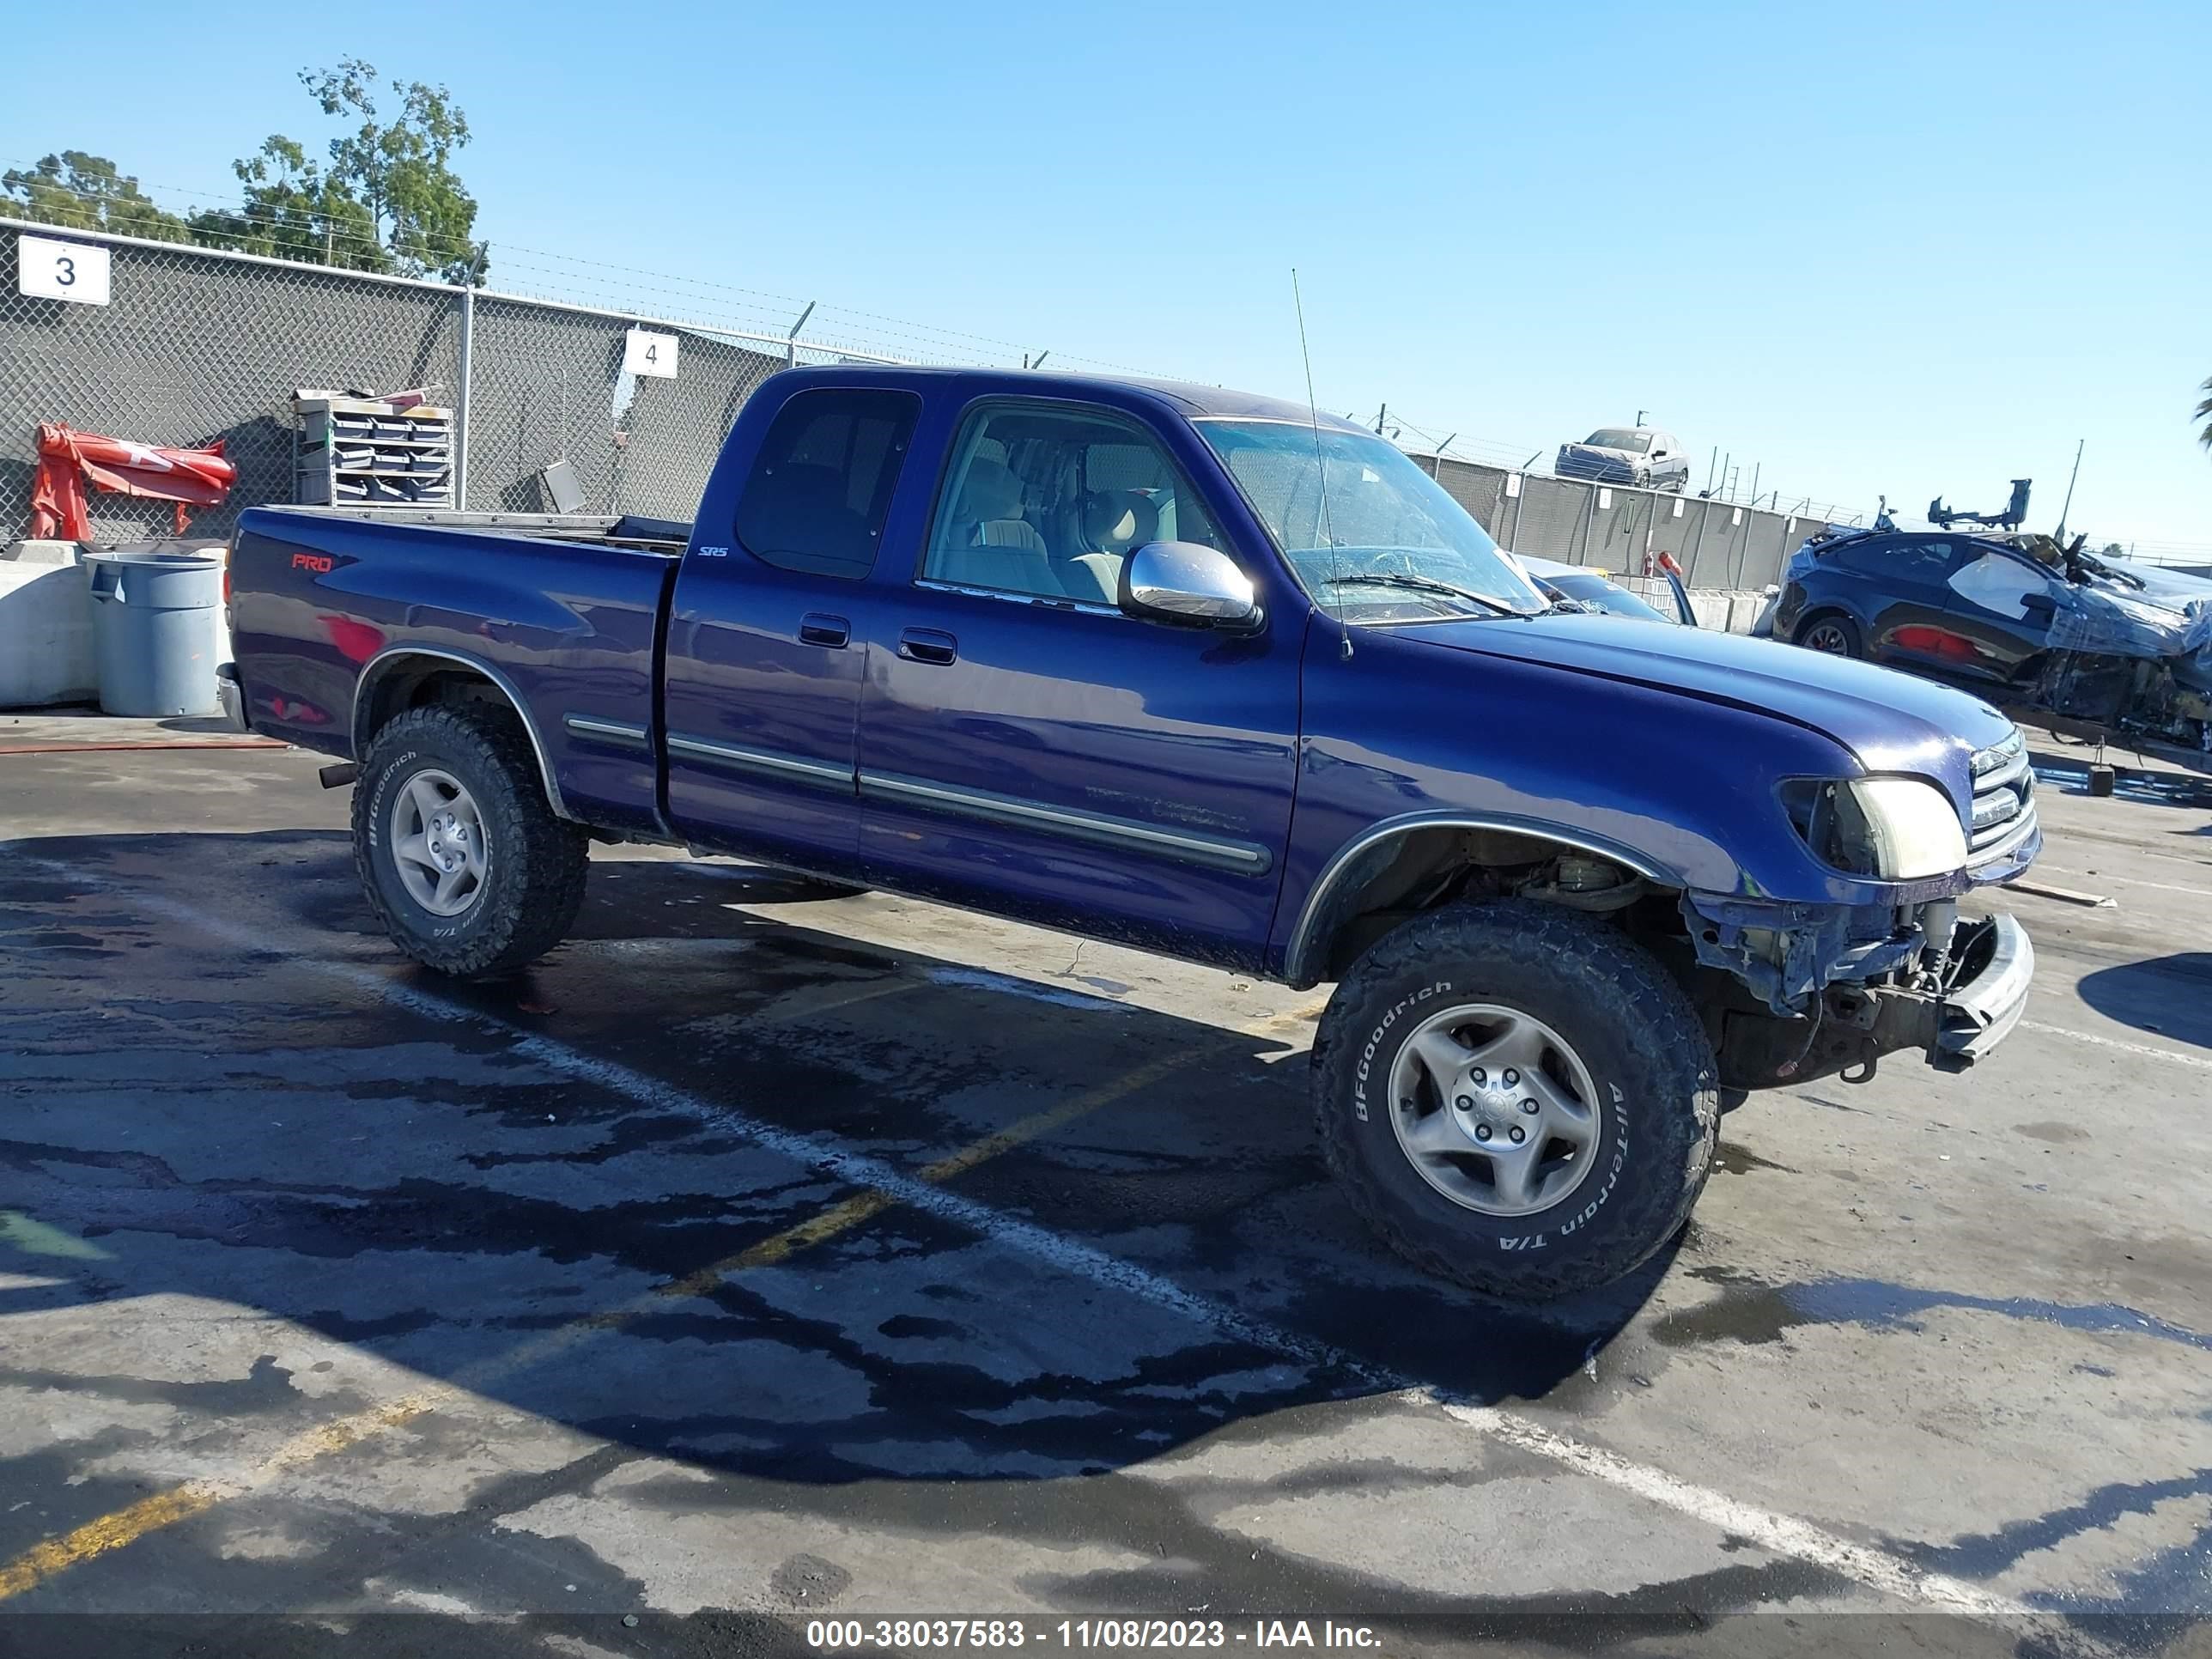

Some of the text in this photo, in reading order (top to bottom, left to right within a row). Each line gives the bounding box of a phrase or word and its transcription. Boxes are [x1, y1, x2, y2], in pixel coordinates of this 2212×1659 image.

[56, 257, 76, 286] 3
[645, 344, 658, 365] 4
[292, 553, 332, 573] PRO
[697, 546, 729, 557] SR5
[368, 750, 416, 847] BFGoodrich
[1355, 981, 1452, 1122] BFGoodrich
[1560, 1081, 1629, 1236] All-Terrain
[1499, 1234, 1547, 1250] T/A
